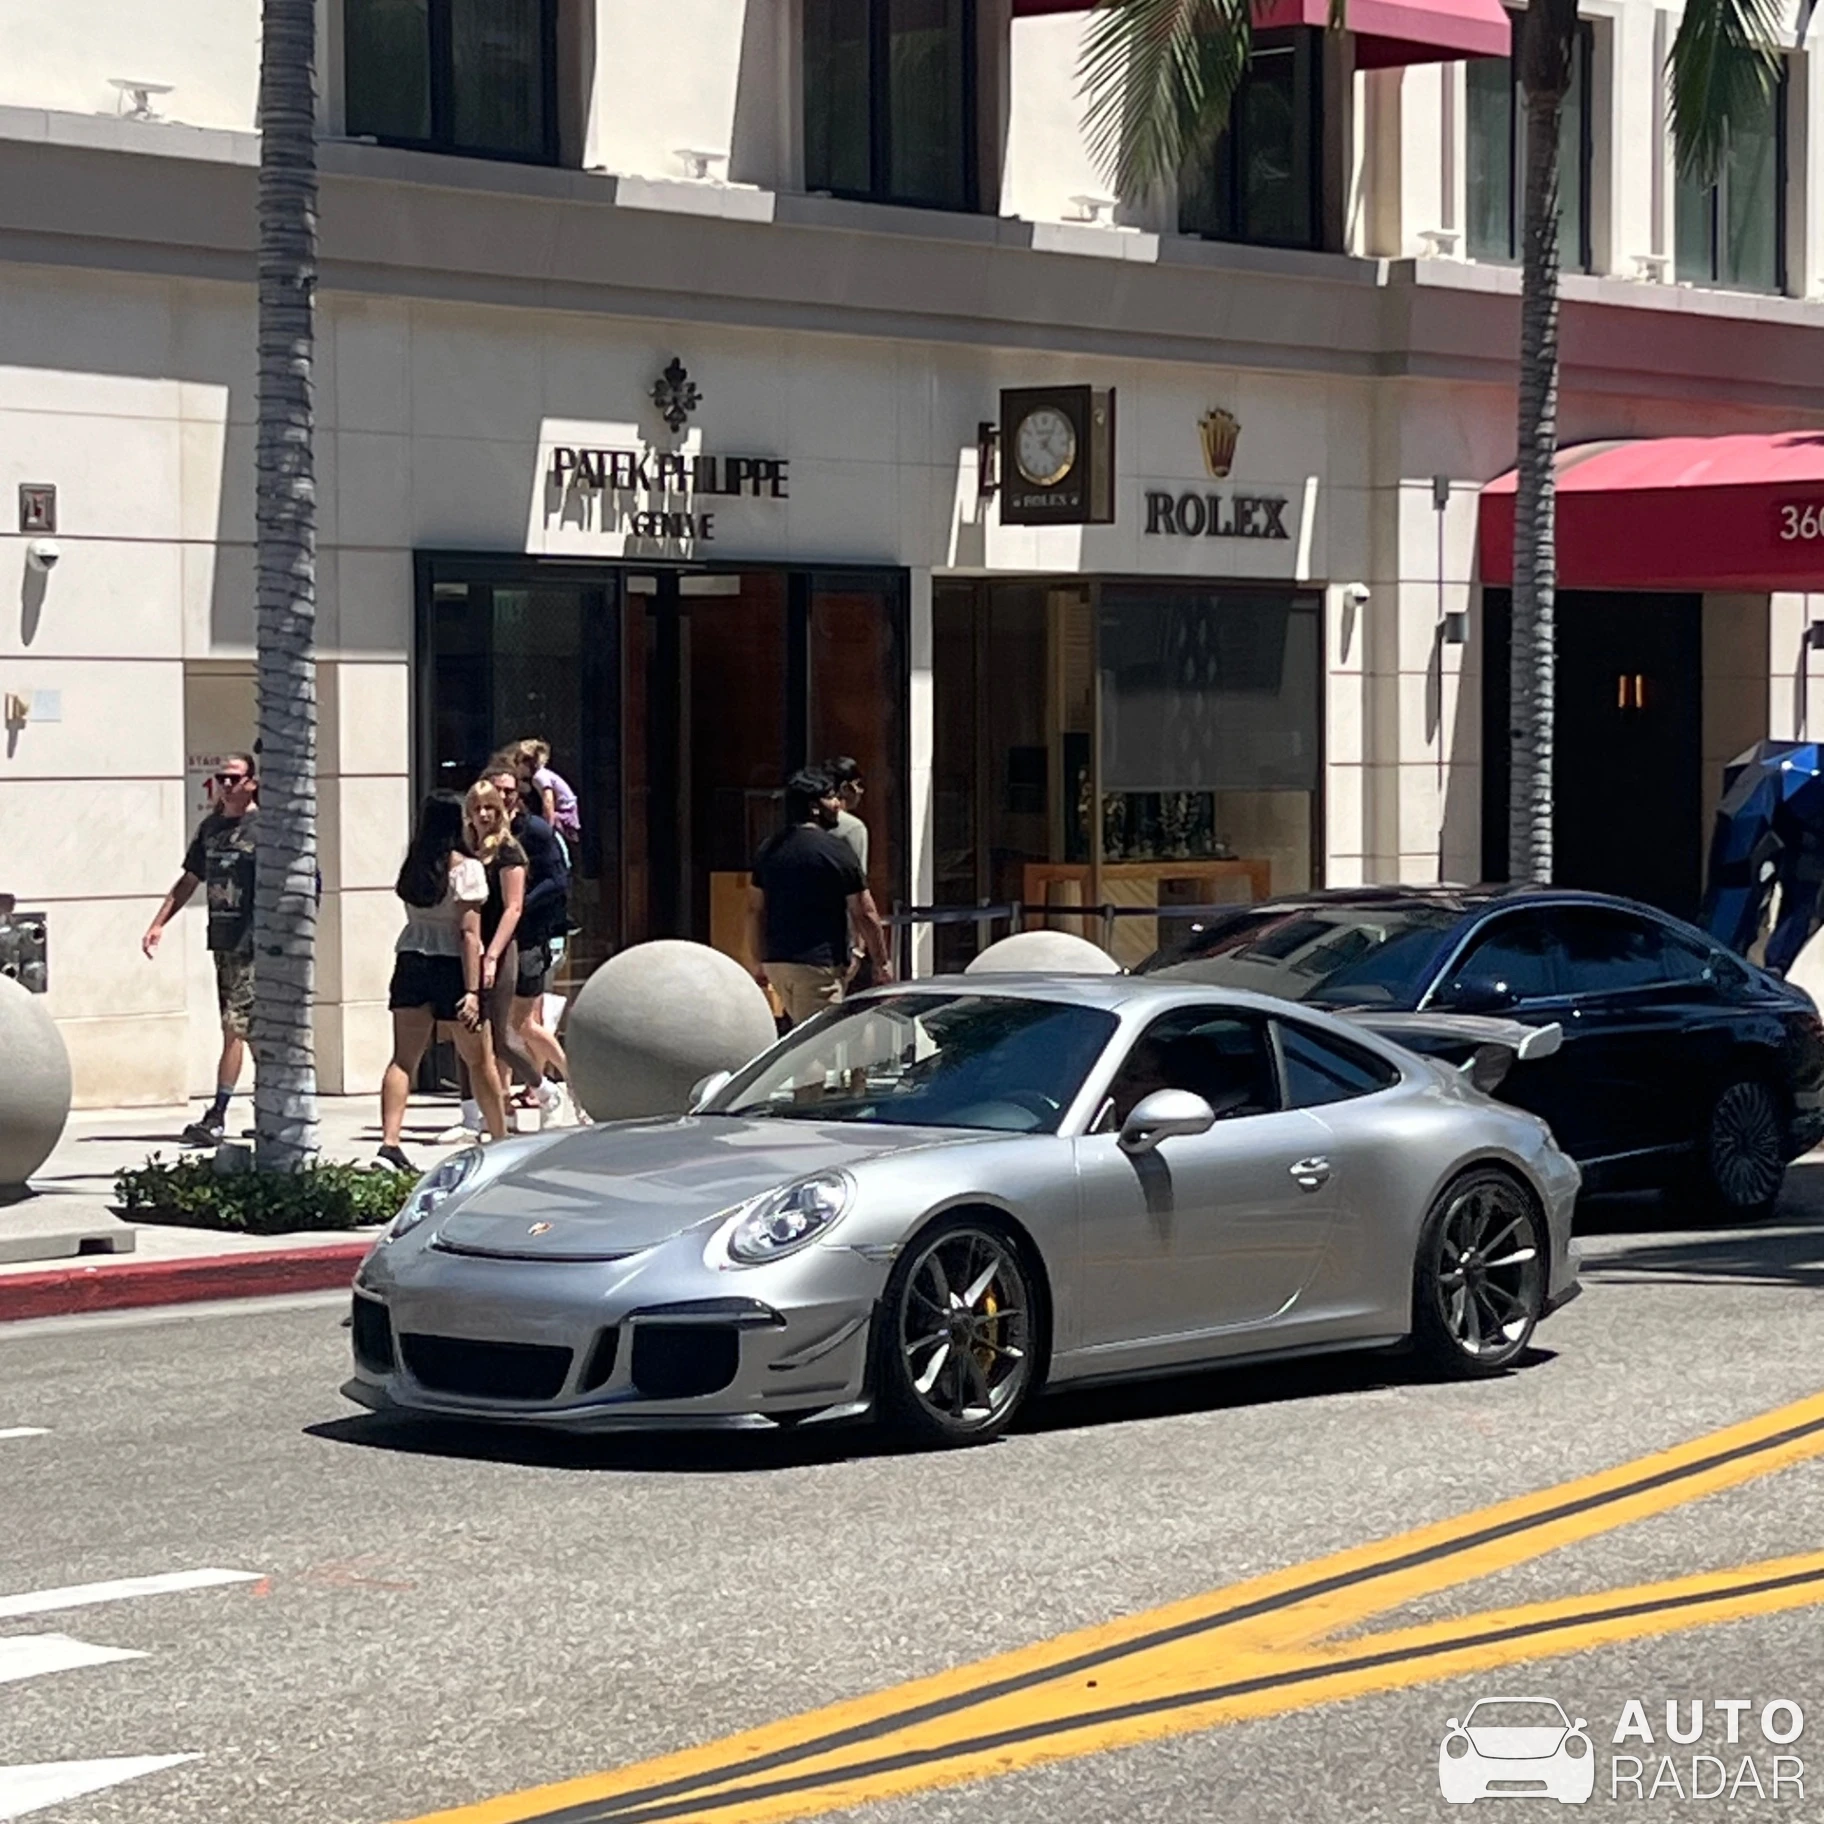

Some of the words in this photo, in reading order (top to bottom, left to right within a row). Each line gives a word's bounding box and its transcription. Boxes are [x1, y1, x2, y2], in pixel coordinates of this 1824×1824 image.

[554, 447, 651, 491] PATEK
[658, 452, 789, 498] PHILIPPE
[1145, 492, 1290, 539] ROLEX
